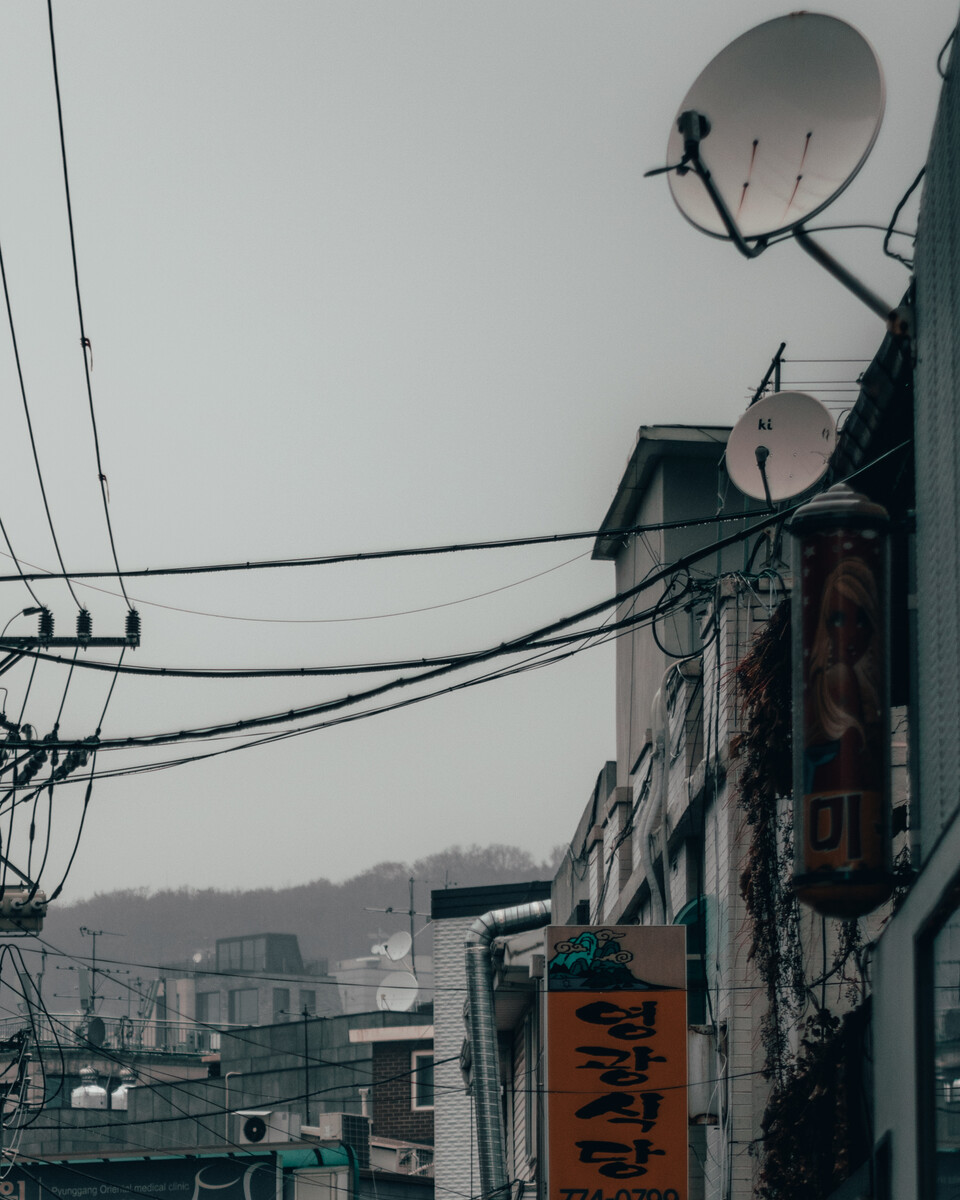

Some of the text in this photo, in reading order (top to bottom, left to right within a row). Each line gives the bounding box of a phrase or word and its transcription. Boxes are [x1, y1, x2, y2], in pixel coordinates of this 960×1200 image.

[575, 1001, 667, 1179] 영광식당
[51, 1186, 98, 1197] Pyunggang
[134, 1183, 166, 1194] medical
[168, 1182, 190, 1191] clinic
